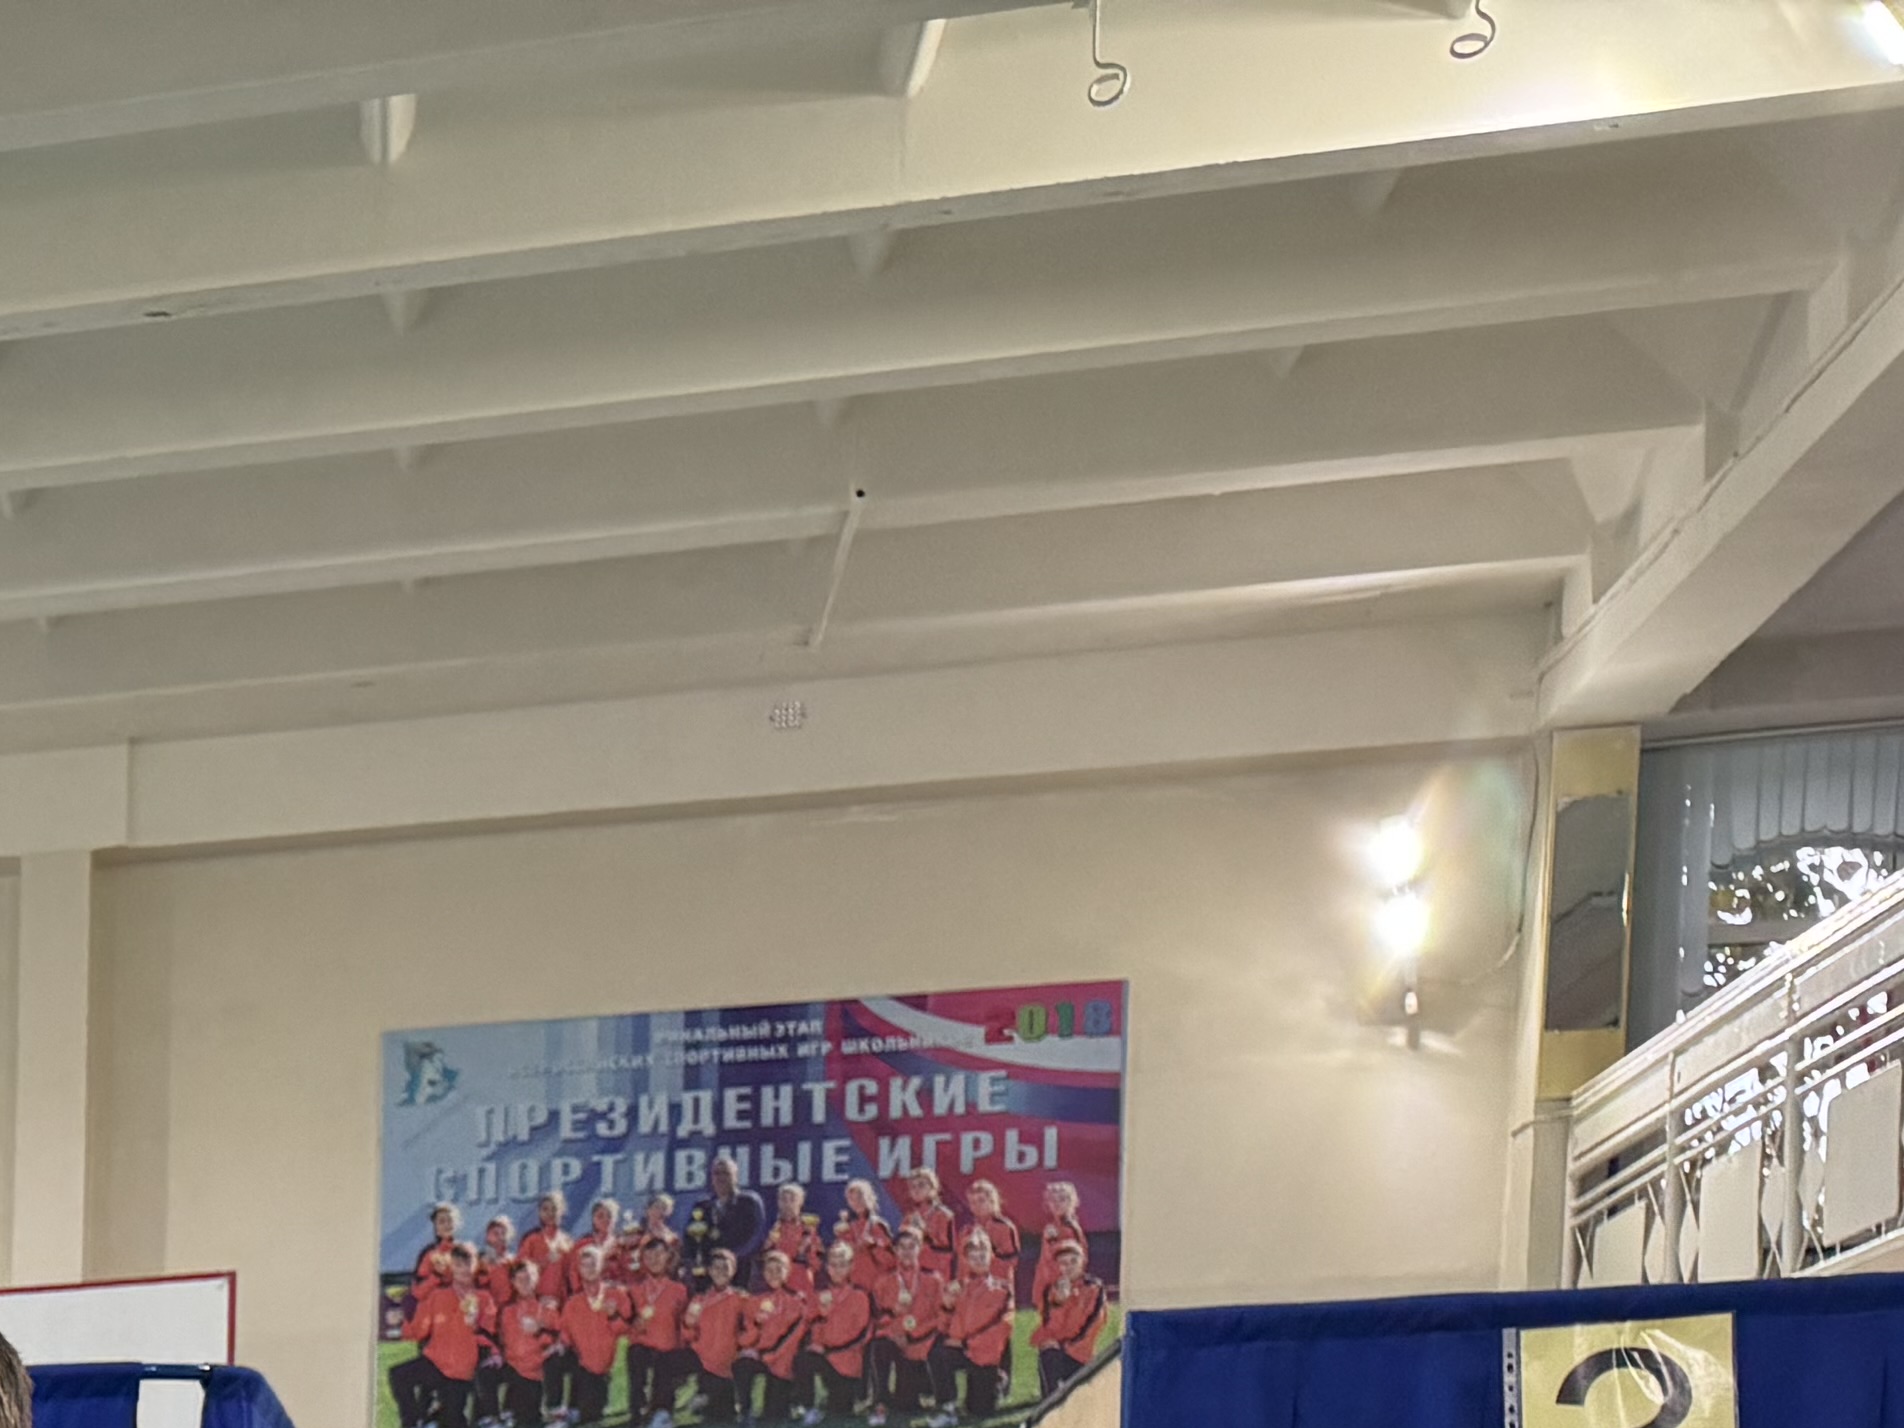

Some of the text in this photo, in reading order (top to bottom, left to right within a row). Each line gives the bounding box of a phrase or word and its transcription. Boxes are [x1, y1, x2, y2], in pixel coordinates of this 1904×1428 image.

[774, 1018, 825, 1040] ЭТАП
[984, 1000, 1113, 1044] 2018
[796, 1040, 833, 1058] ИГР
[842, 1033, 978, 1056] ШКОЛЬНИ
[475, 1070, 1010, 1147] ПРЕЗИДЕНТСКИЕ
[432, 1125, 1059, 1205] СПОРТИВНЫЕ ИГРЫ
